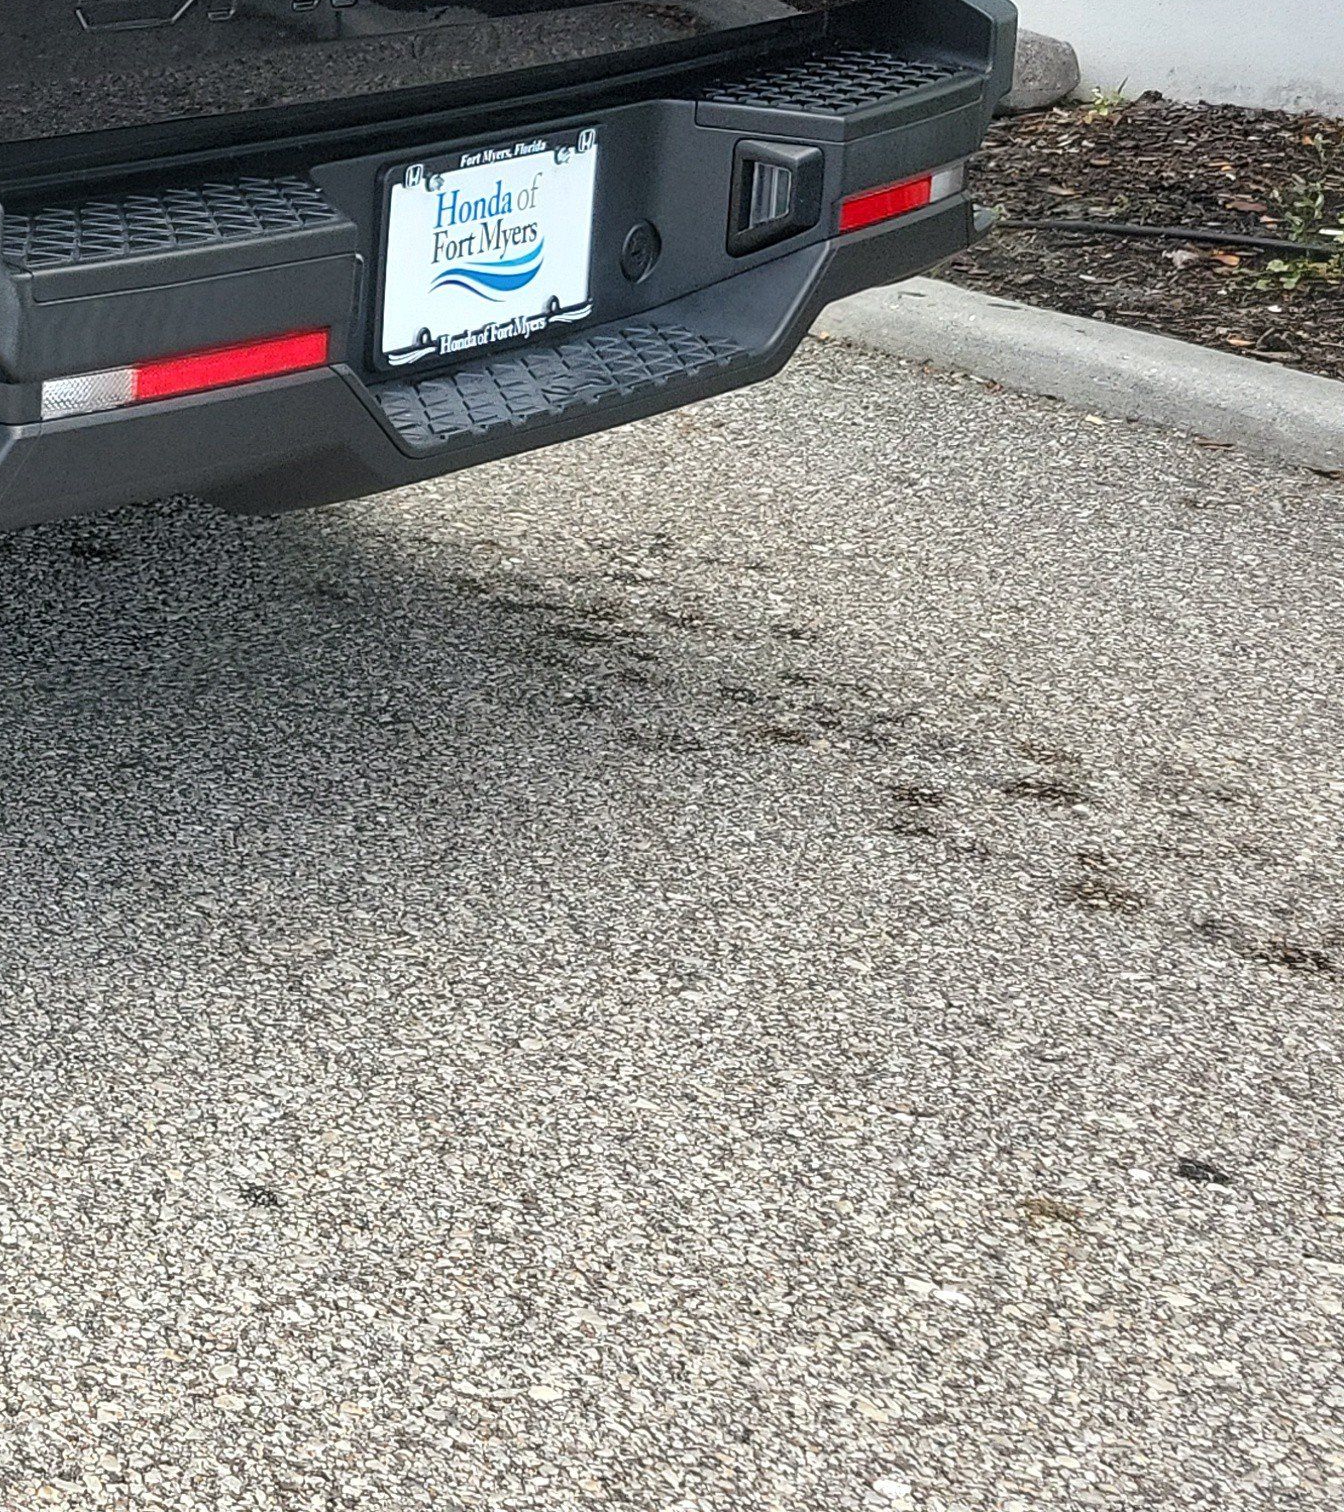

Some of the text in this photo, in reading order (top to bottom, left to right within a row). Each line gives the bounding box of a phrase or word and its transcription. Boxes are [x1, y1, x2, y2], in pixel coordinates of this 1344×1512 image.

[460, 153, 479, 168] Fort
[514, 139, 547, 156] Florida
[433, 171, 544, 230] Honda of
[431, 217, 539, 265] Fort Myers
[439, 316, 548, 355] Honda of Fort Myers
